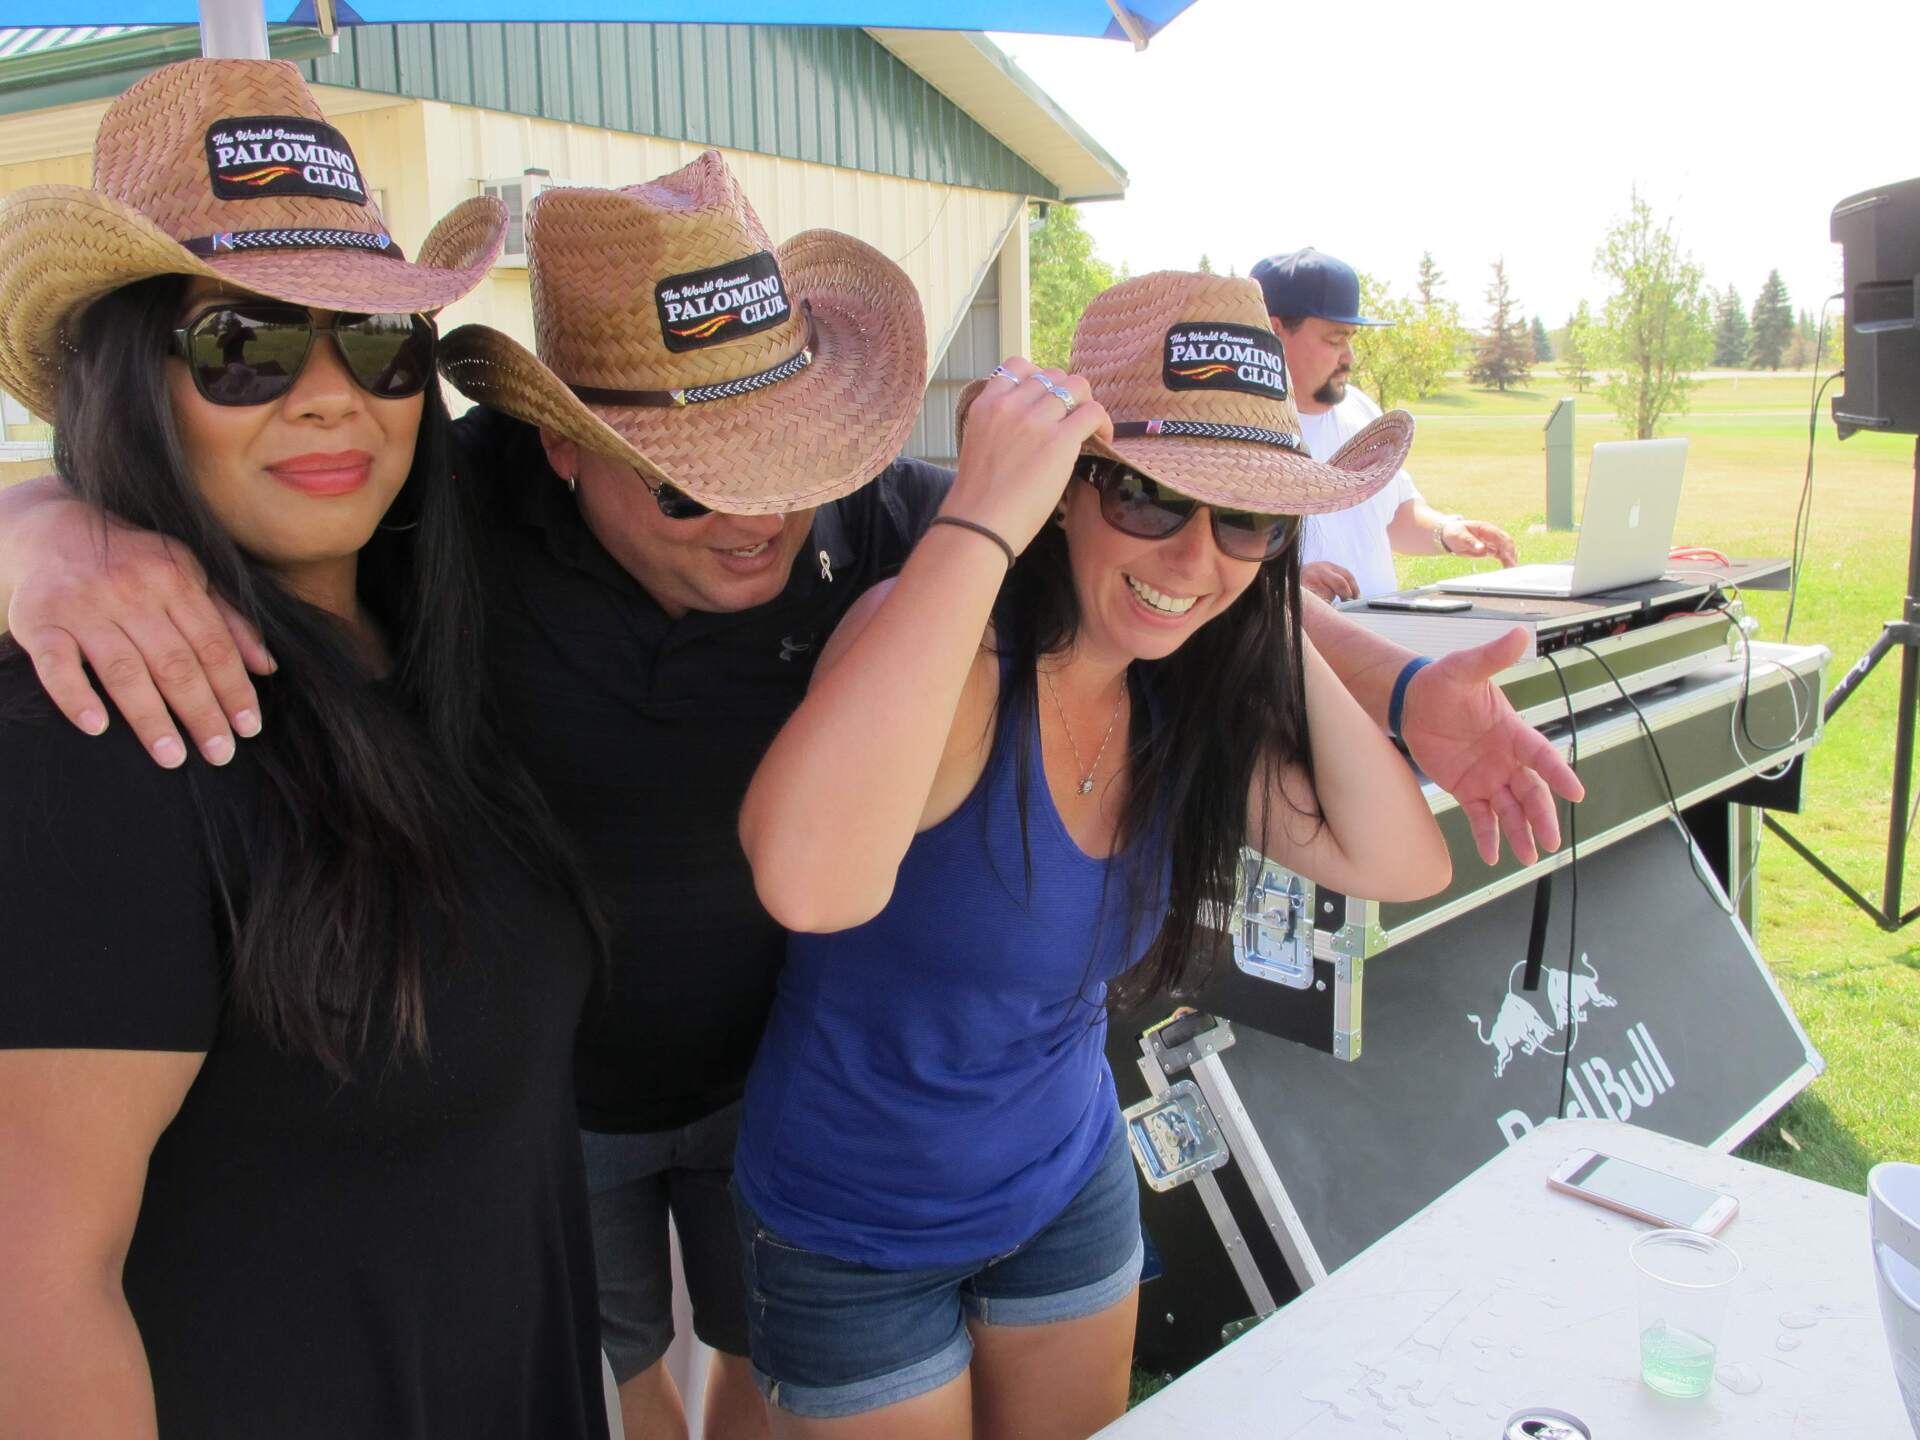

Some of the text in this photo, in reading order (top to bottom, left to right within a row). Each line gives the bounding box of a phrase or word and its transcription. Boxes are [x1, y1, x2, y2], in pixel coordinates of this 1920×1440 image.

[212, 128, 317, 146] The World Famous
[216, 143, 354, 173] PALOMINO
[302, 165, 362, 193] CLUB
[661, 273, 751, 303] The World Famous
[664, 275, 780, 323] PALOMINO
[740, 295, 787, 325] CLUB
[1170, 331, 1255, 345] The World Famous
[1170, 343, 1282, 373] PALOMINO
[1237, 365, 1285, 391] CLUB
